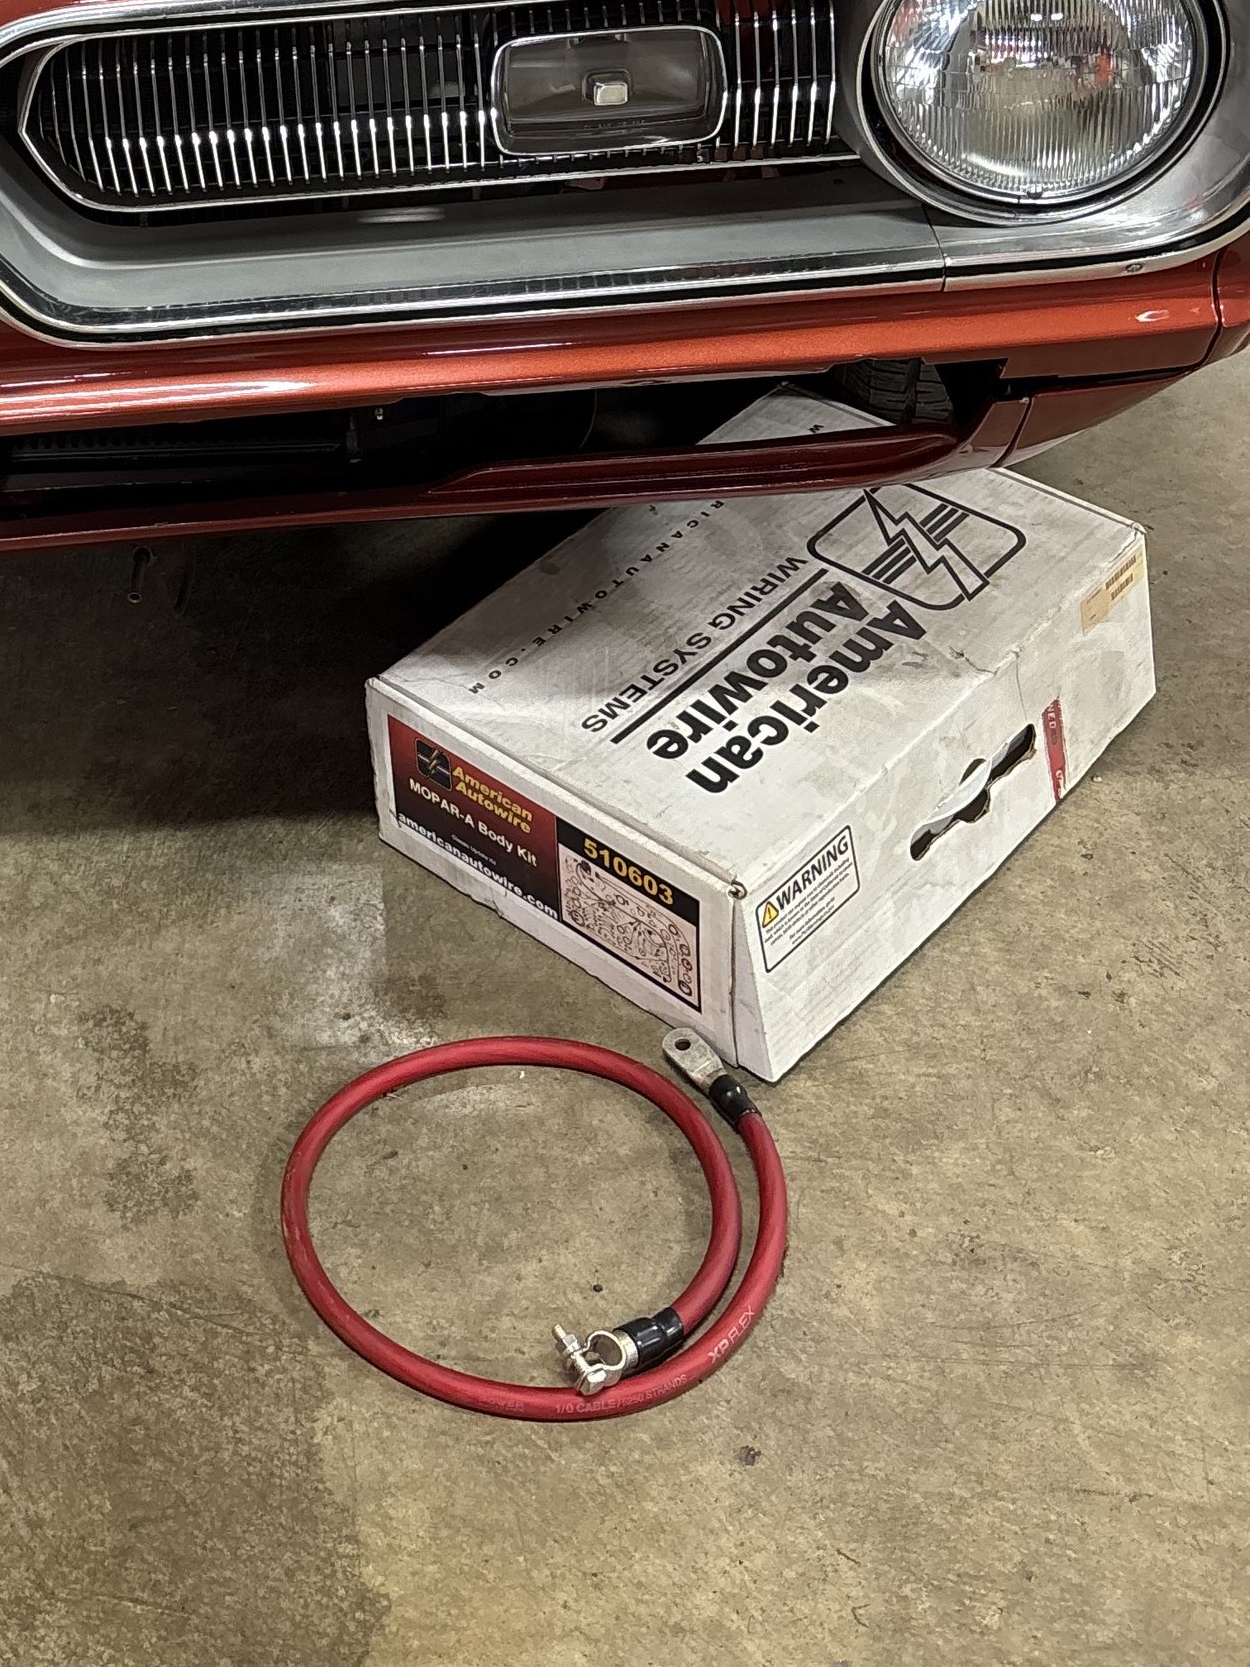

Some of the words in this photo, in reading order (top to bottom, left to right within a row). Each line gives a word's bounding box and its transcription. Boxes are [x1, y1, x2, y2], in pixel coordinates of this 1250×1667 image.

[707, 555, 809, 631] WIRING
[580, 631, 712, 733] SYSTEMS
[646, 581, 870, 759] Autowire
[685, 599, 928, 794] American
[408, 778, 474, 830] MOPAR-A
[478, 820, 514, 853] Body
[516, 843, 538, 868] Kit
[452, 766, 533, 822] American
[454, 780, 532, 835] Autowire
[397, 811, 559, 921] americanautowire.com
[582, 837, 675, 906] 510603
[776, 834, 849, 911] WARNING
[707, 1339, 730, 1364] XP
[727, 1305, 756, 1343] FLEX
[555, 1402, 574, 1414] 1/0
[576, 1397, 617, 1413] CABLE
[645, 1374, 687, 1400] STRANDS
